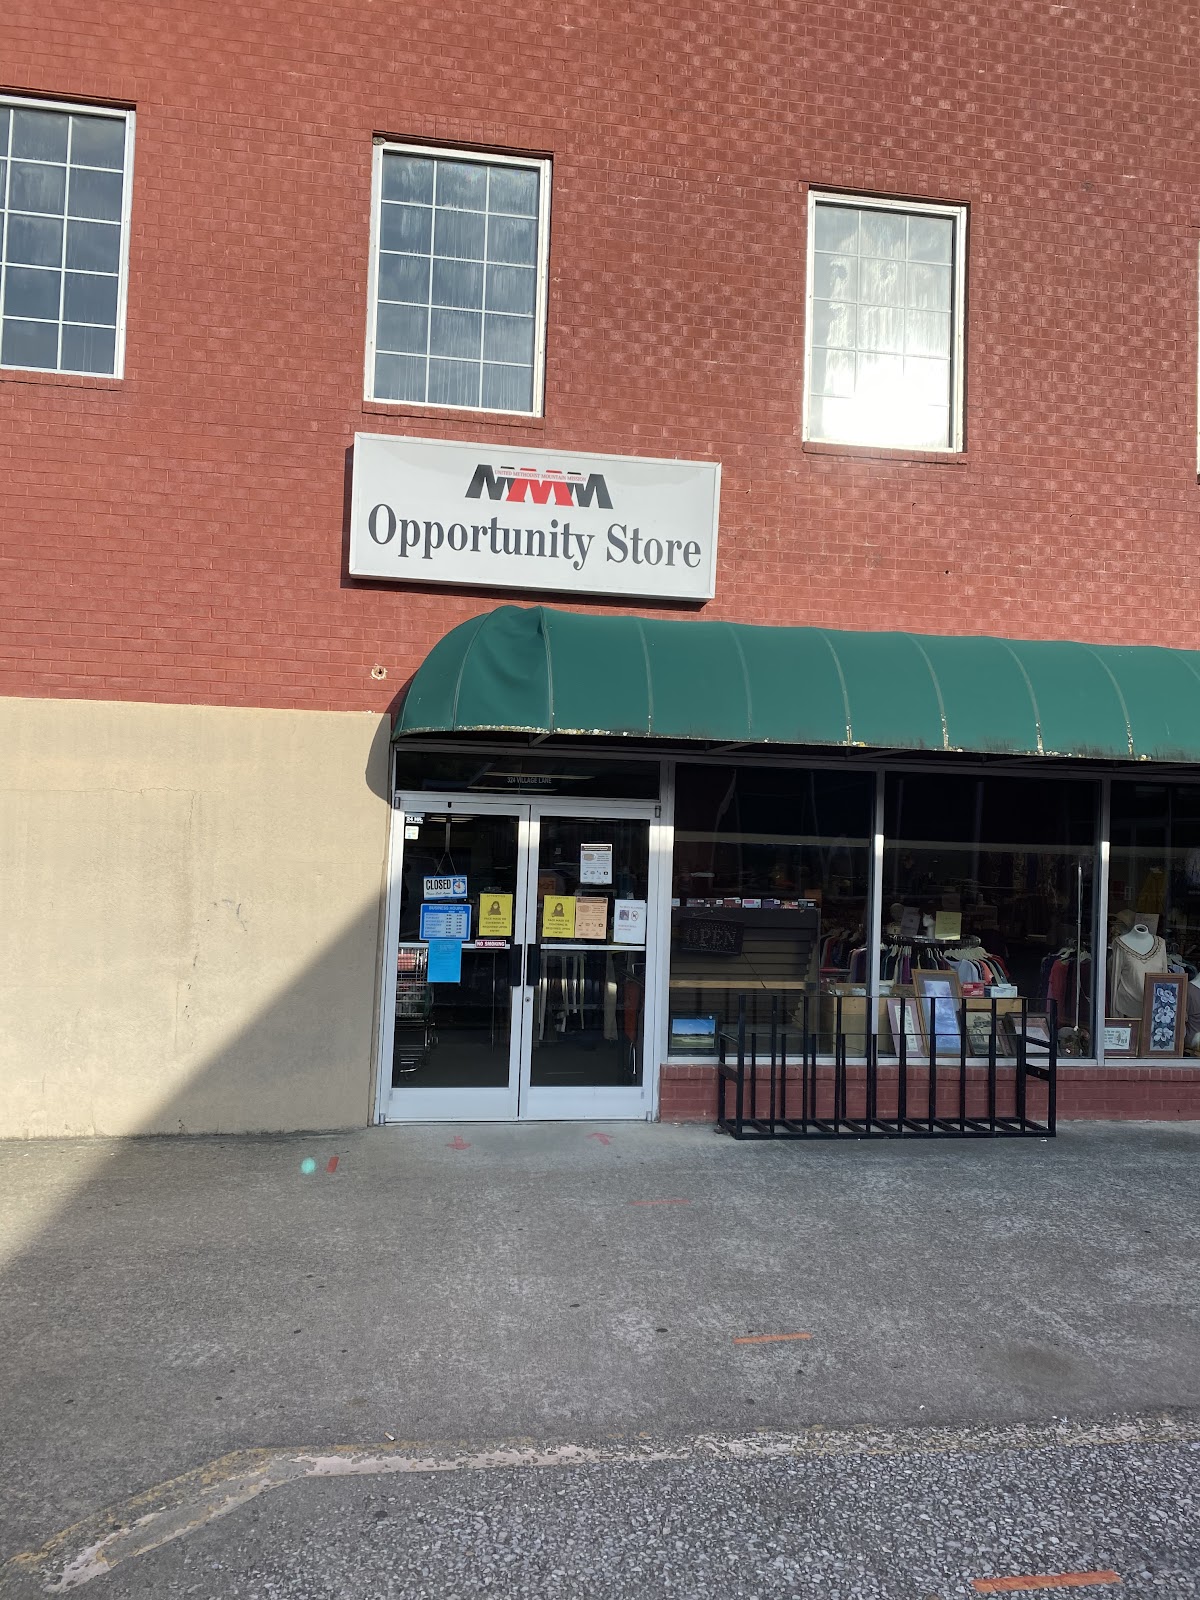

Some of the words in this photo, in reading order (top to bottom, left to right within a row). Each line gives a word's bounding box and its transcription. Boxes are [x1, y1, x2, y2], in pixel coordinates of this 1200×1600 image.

[513, 471, 540, 479] METHODIST
[367, 502, 595, 571] Opportunity
[606, 523, 702, 569] Store
[425, 879, 451, 890] CLOSED
[686, 928, 737, 947] OPEN
